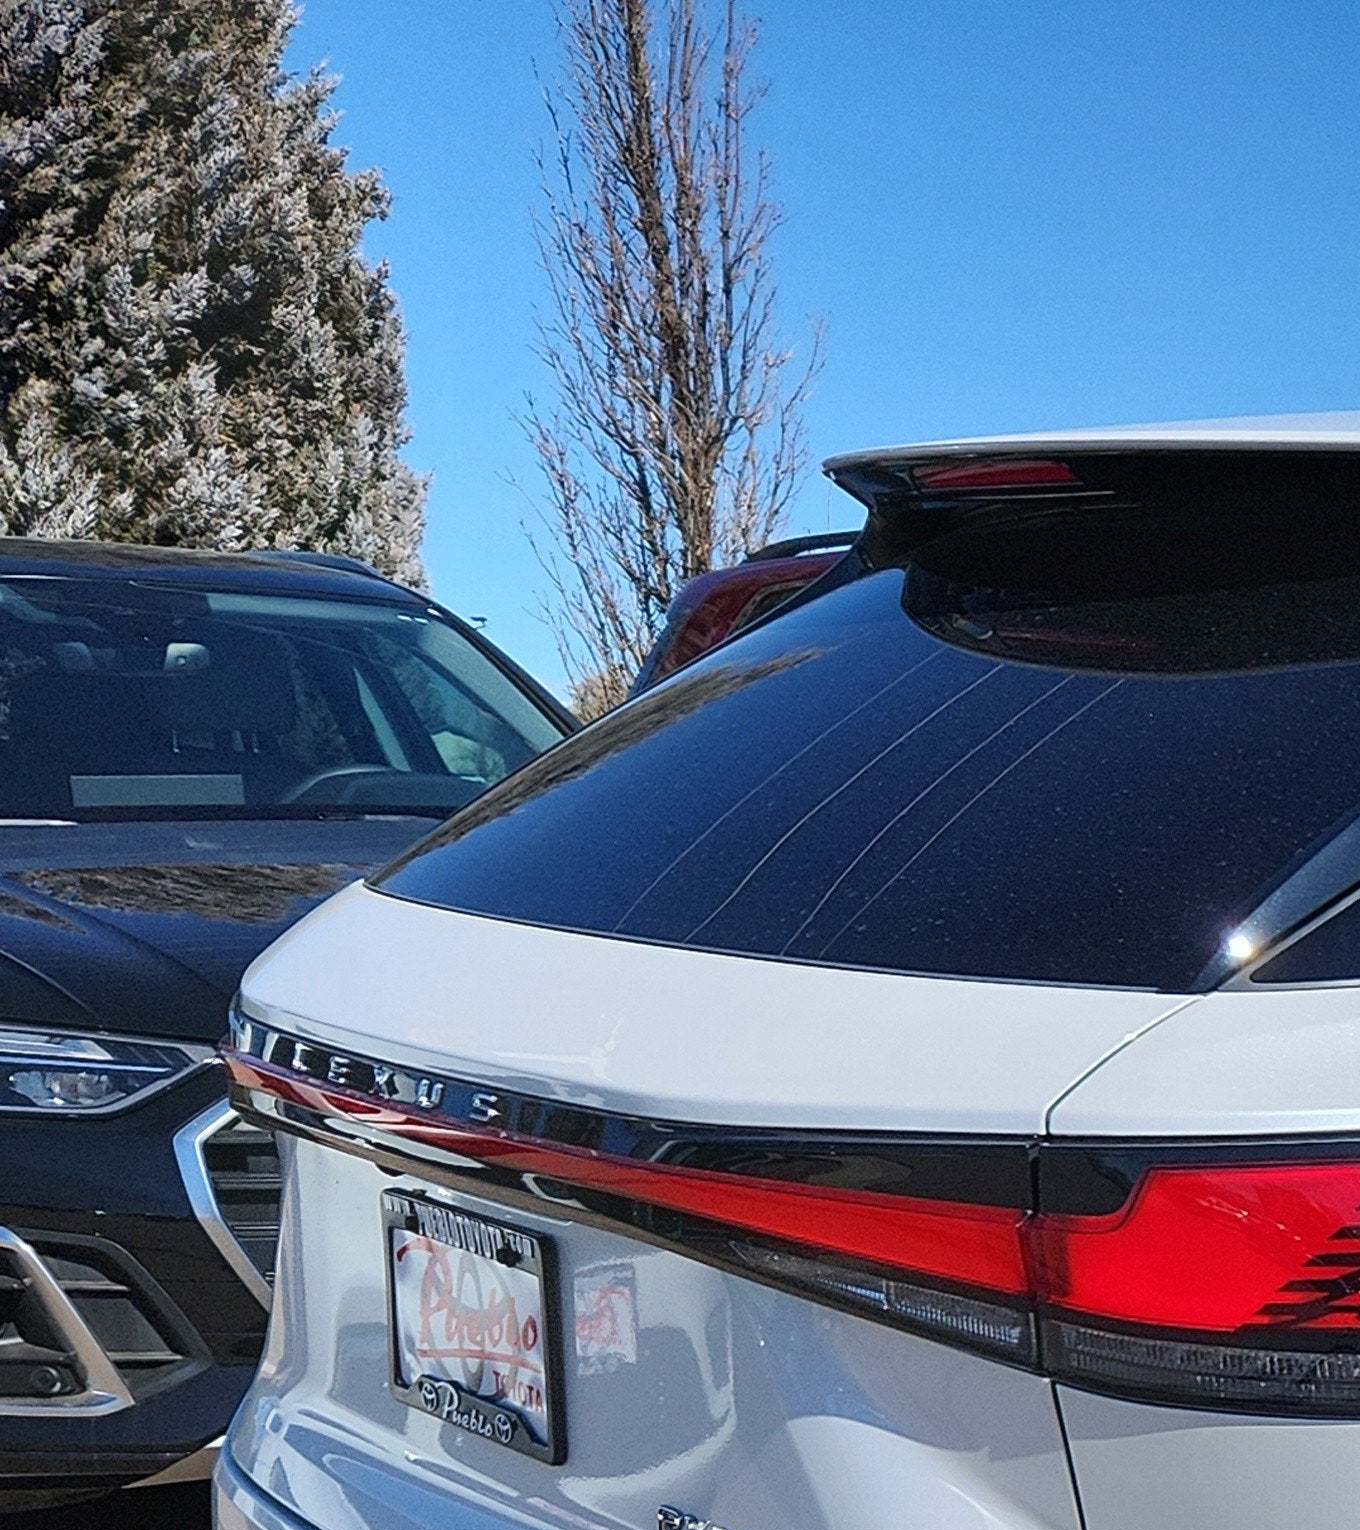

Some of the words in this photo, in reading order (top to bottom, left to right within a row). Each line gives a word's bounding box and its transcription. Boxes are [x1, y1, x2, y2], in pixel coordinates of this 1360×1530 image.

[291, 1041, 501, 1122] LEXUS
[397, 1237, 537, 1351] Pueblo
[435, 1381, 494, 1437] Pueblo
[493, 1371, 545, 1415] TOYOTA
